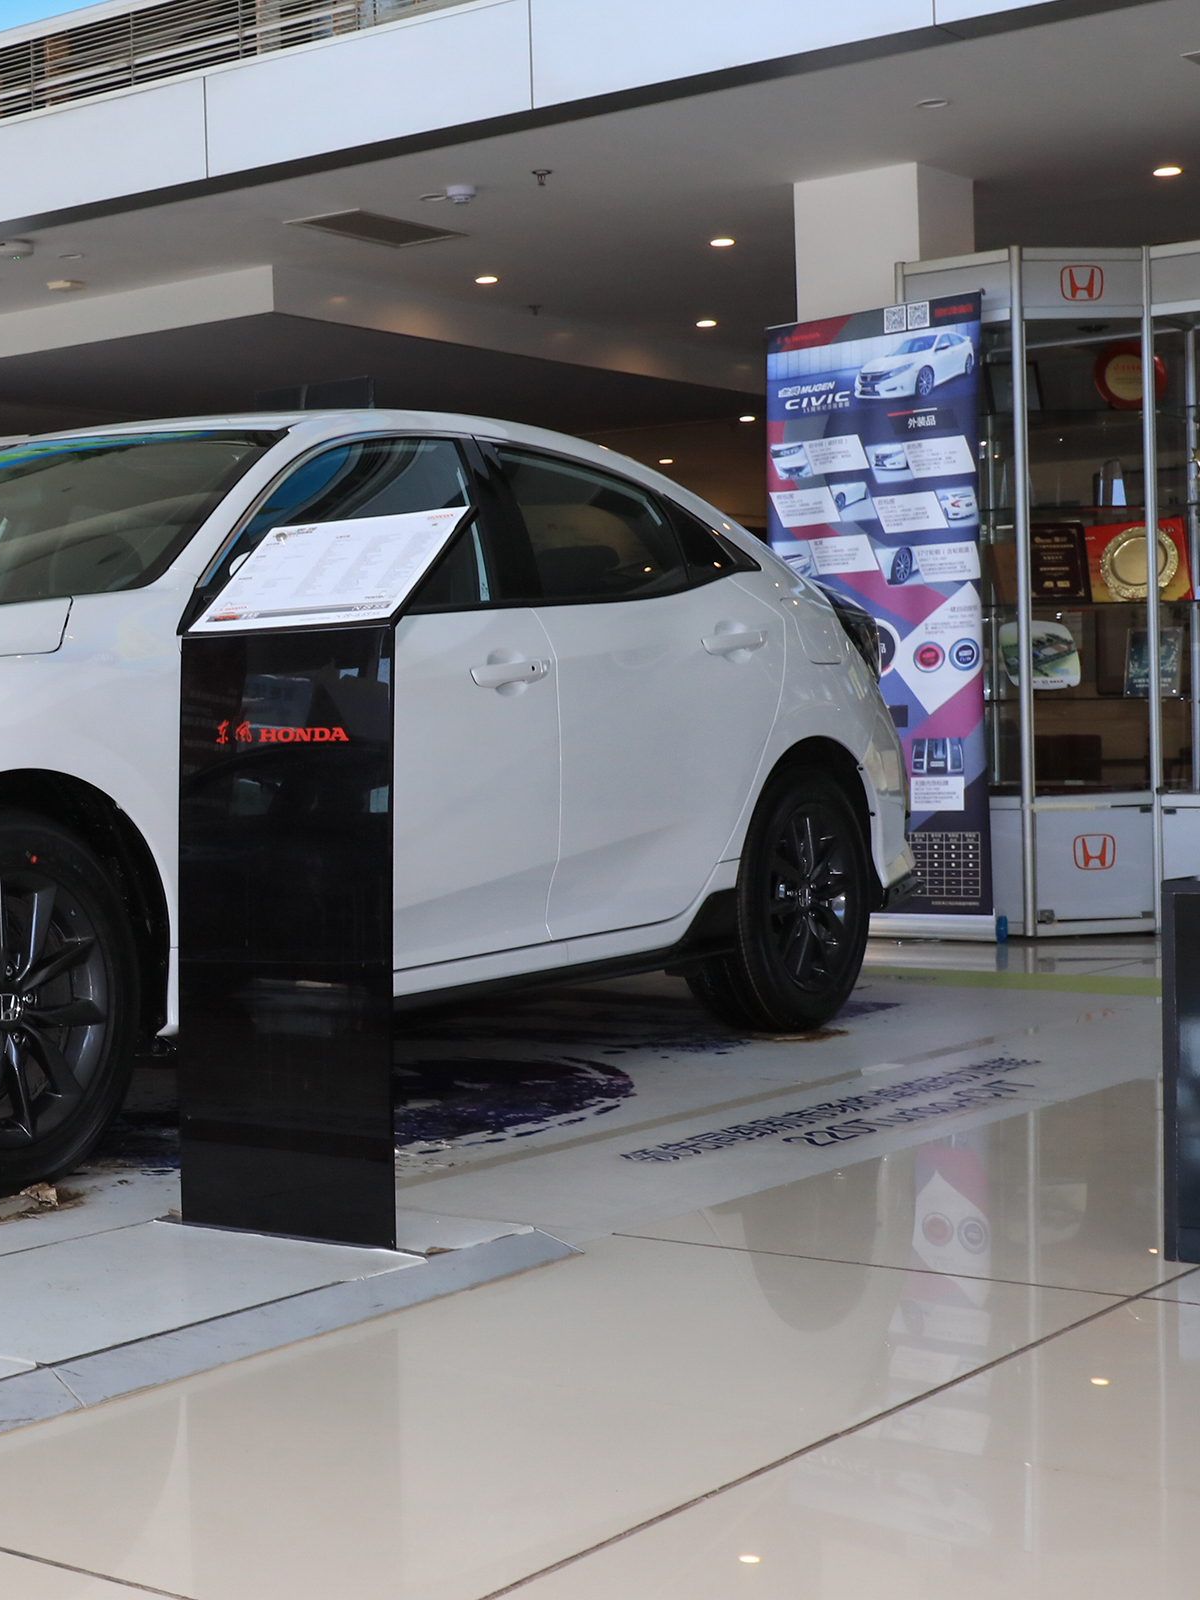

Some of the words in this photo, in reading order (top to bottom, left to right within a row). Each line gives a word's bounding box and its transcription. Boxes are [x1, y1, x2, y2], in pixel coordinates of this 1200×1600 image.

[800, 381, 835, 395] MUGEN
[785, 390, 850, 410] CIVIC
[907, 415, 936, 429] 外装品
[259, 726, 350, 744] HONDA
